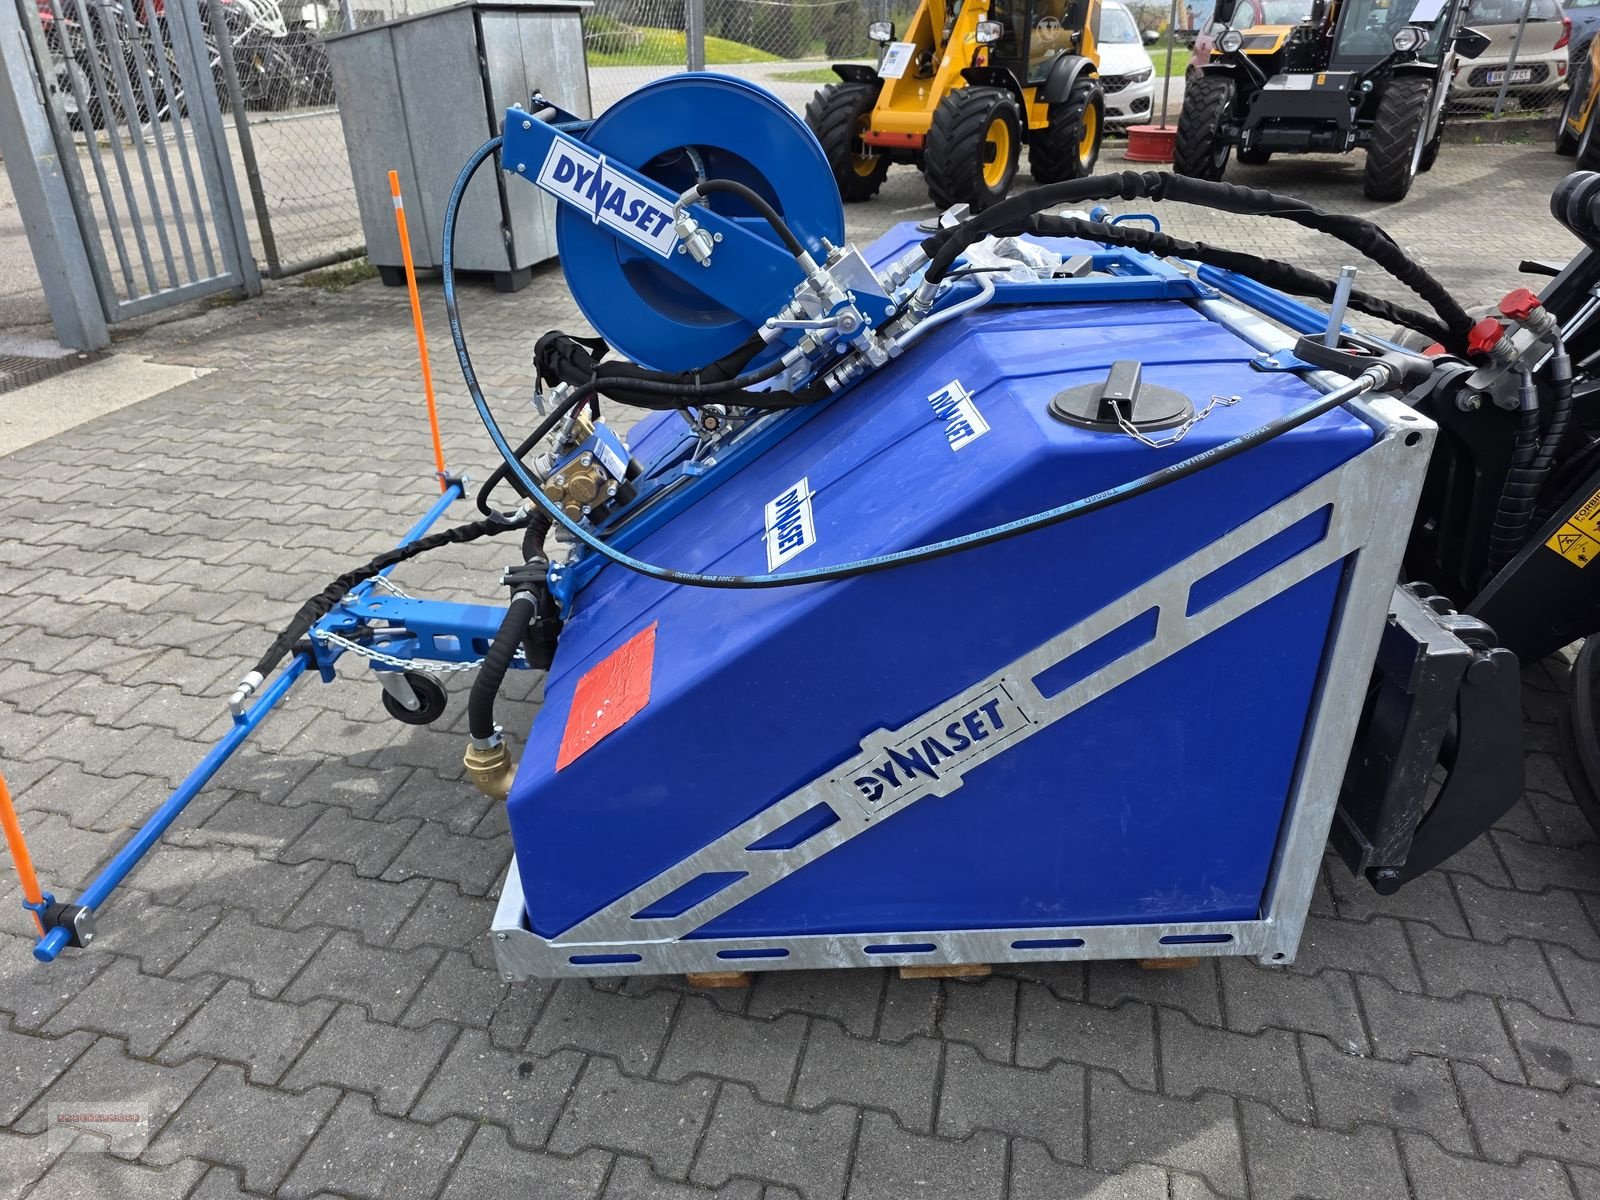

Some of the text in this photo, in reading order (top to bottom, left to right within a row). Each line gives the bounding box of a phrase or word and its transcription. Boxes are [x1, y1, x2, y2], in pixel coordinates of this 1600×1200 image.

[552, 154, 674, 238] DYNASET
[767, 488, 808, 555] DYNASET
[853, 697, 1005, 803] DYNASET
